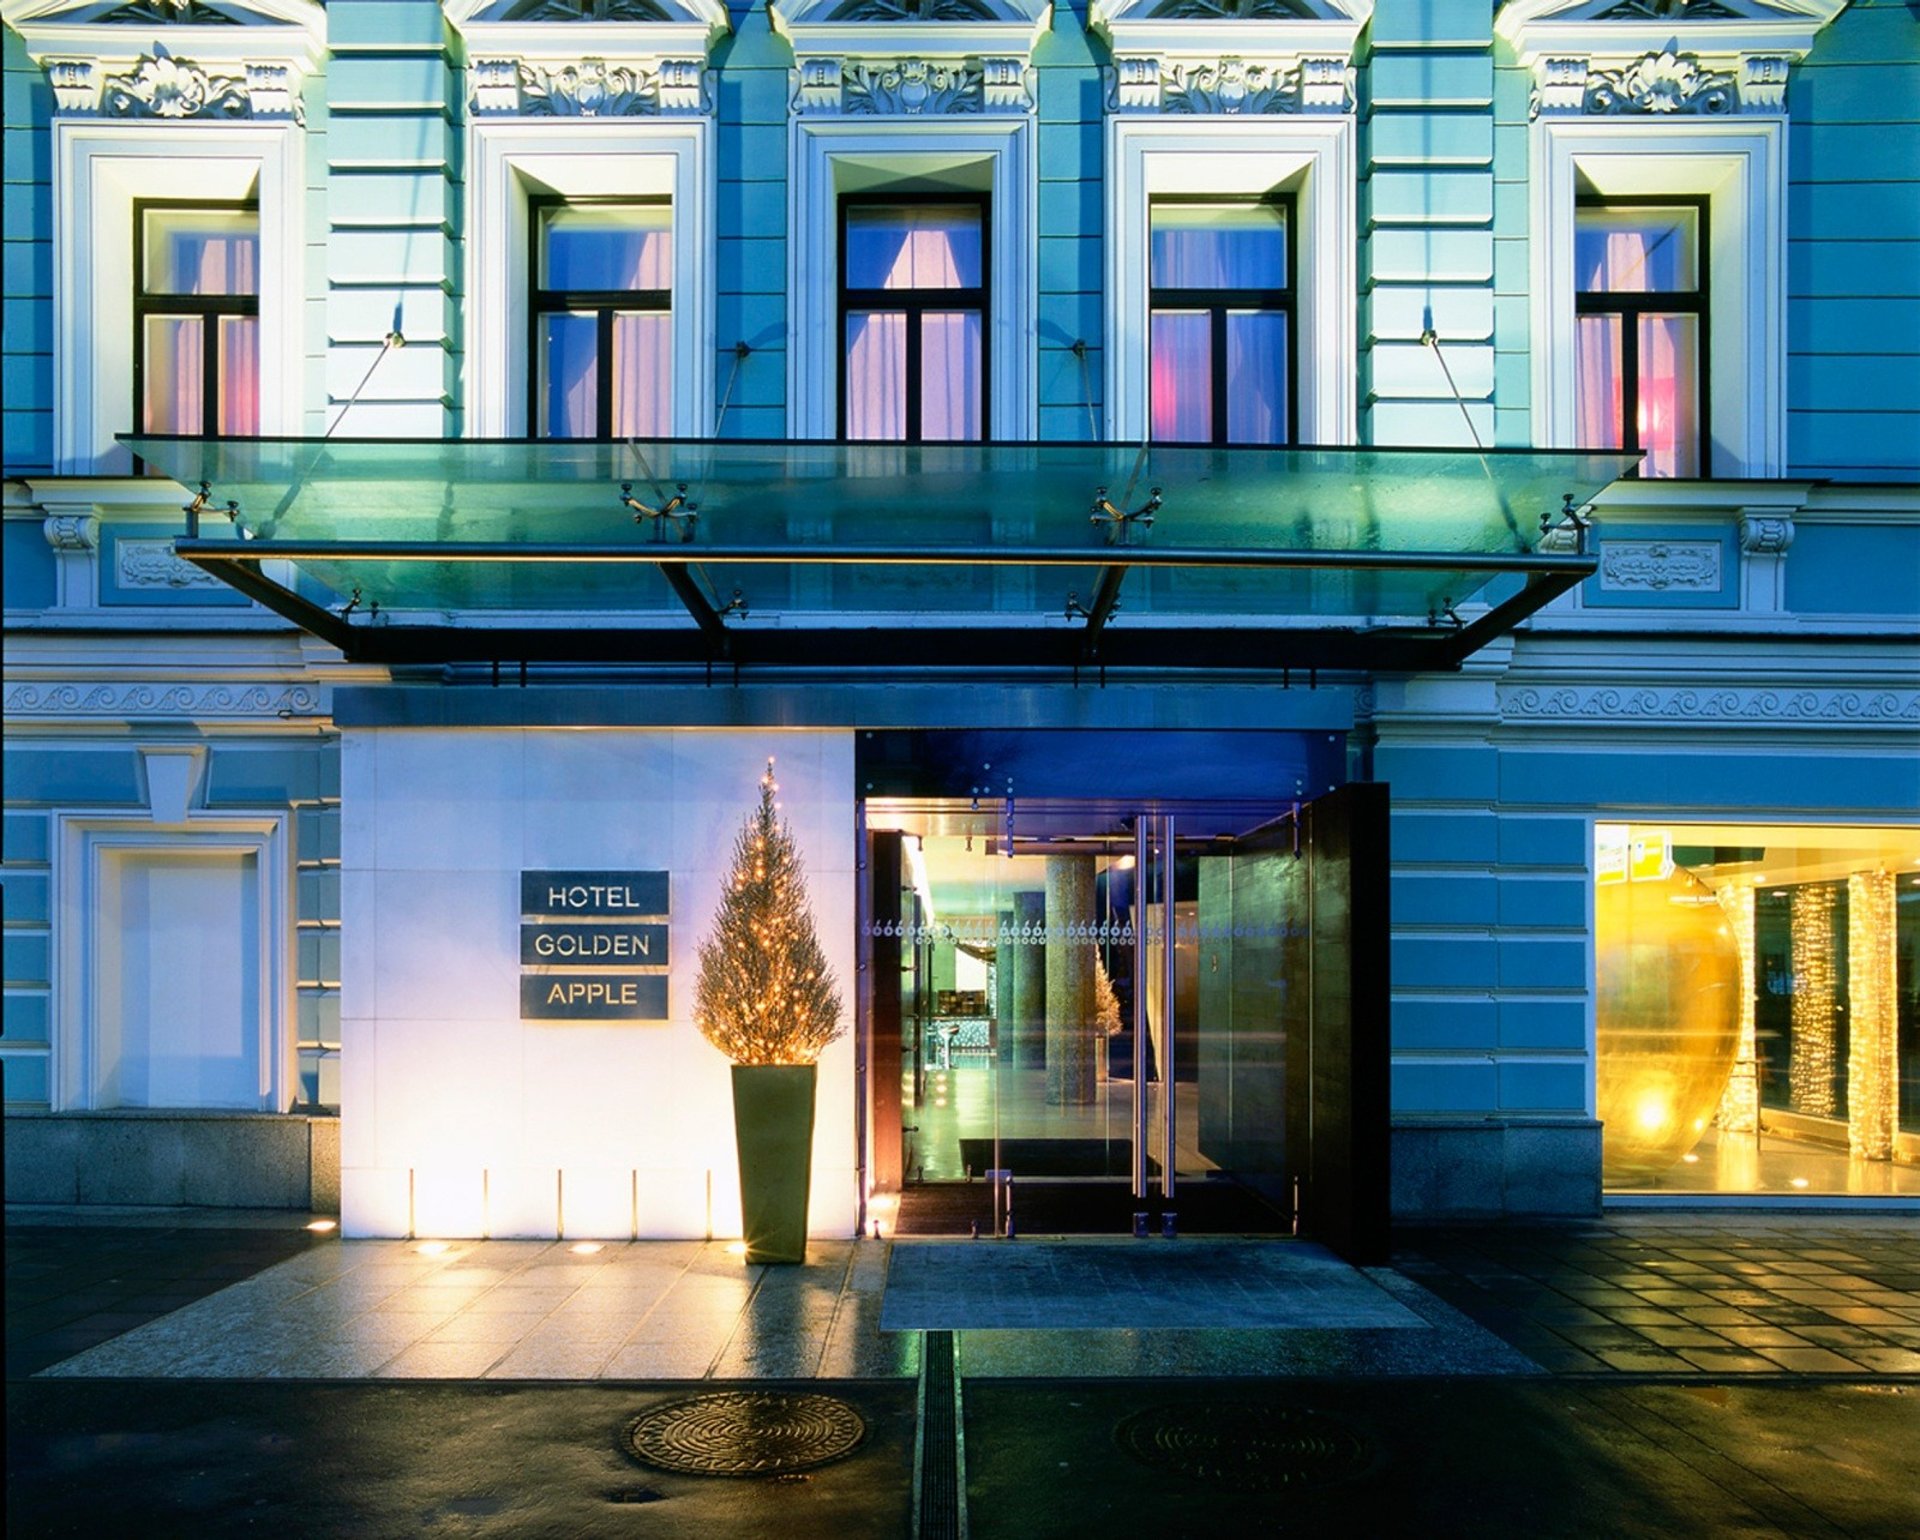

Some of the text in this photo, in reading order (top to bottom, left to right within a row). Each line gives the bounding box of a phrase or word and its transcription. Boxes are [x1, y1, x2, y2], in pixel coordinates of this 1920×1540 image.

[548, 886, 640, 907] HOTEL
[535, 934, 649, 956] GOLDEN
[547, 983, 638, 1004] APPLE
